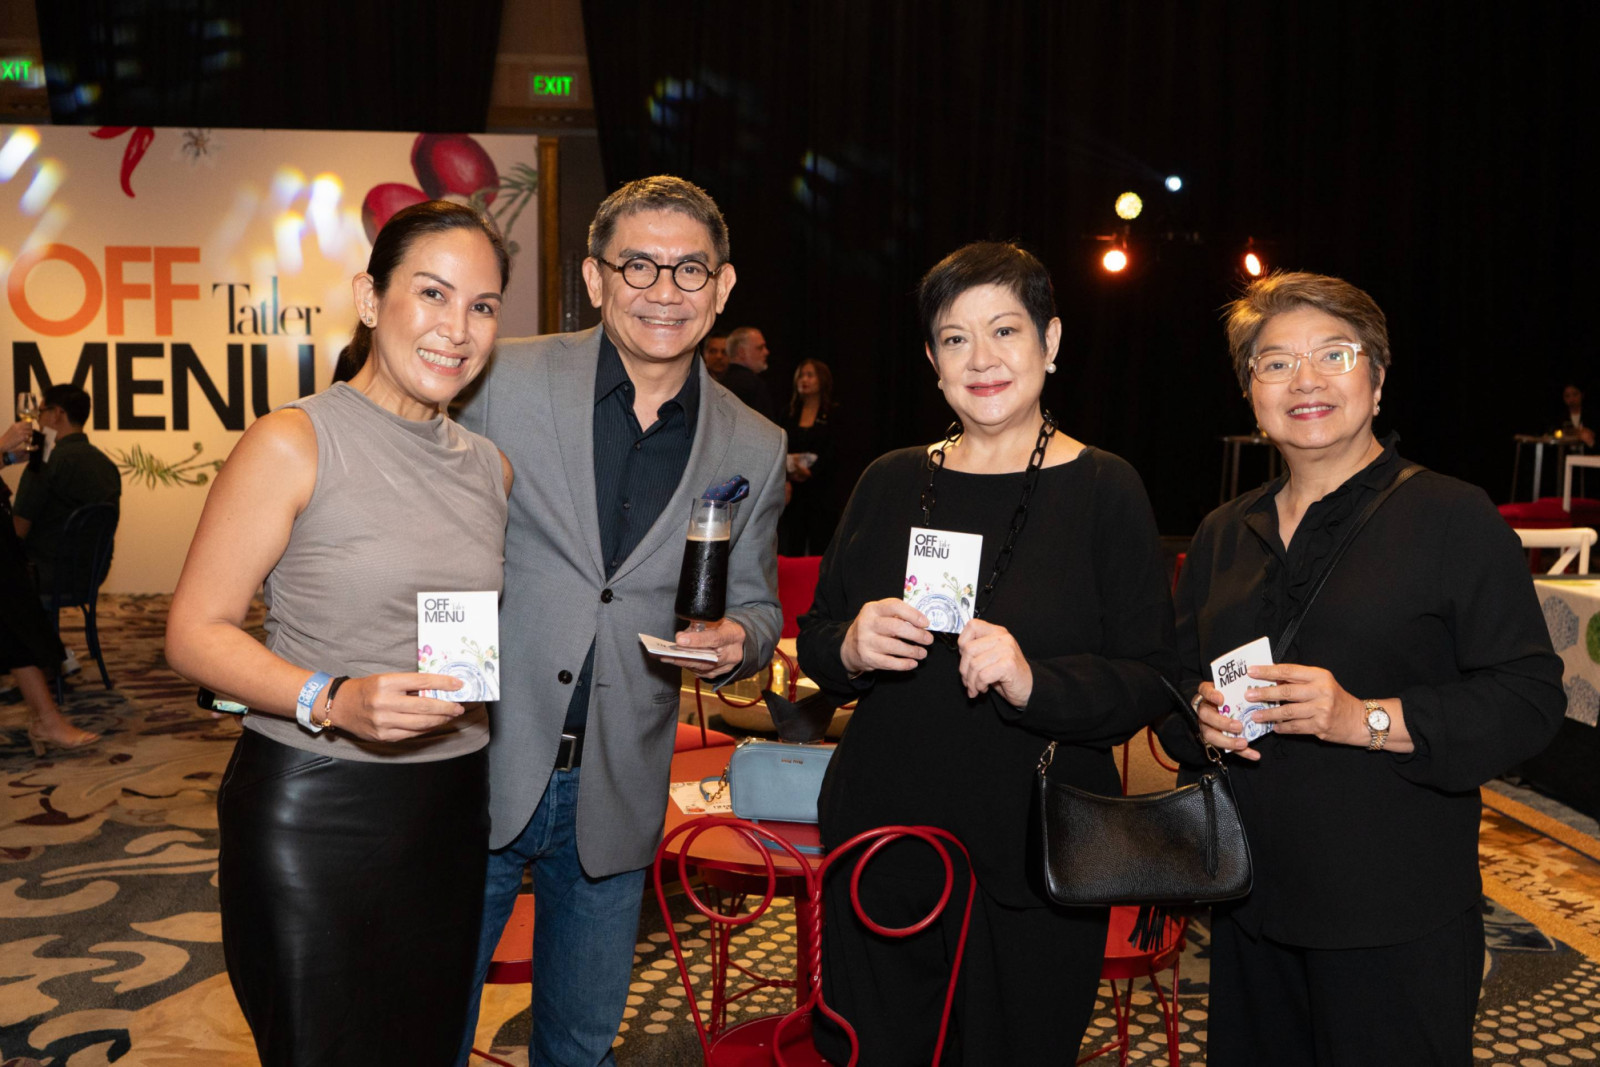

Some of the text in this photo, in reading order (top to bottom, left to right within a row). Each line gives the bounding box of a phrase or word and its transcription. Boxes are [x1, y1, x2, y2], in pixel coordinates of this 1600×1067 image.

[0, 60, 32, 80] XIT
[533, 75, 573, 96] EXIT
[7, 243, 200, 337] OFF
[212, 275, 321, 336] Tatler
[12, 341, 315, 432] MENU
[915, 534, 937, 546] OFF
[914, 545, 949, 559] MENU
[424, 598, 450, 611] OFF
[424, 610, 465, 623] MENU
[1218, 660, 1235, 676] OFF
[1219, 665, 1247, 687] MENU
